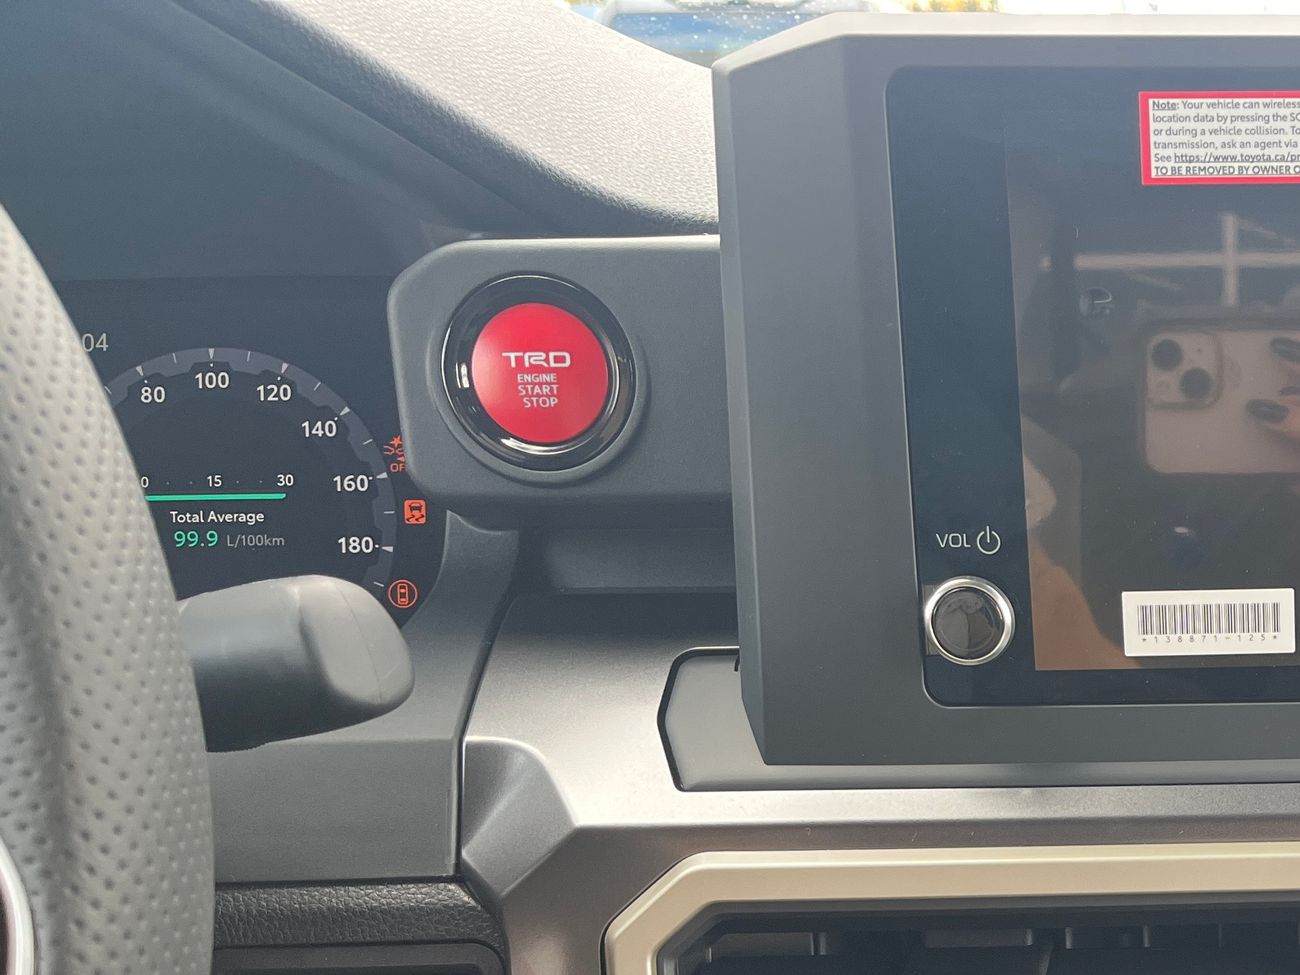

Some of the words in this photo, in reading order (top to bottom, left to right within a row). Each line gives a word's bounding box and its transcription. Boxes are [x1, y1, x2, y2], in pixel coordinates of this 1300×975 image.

[1152, 100, 1179, 110] Note:
[1182, 100, 1204, 110] Your
[1206, 99, 1240, 109] vehicle
[1242, 101, 1260, 109] can
[1152, 113, 1190, 123] location
[1192, 113, 1215, 122] data
[1217, 113, 1228, 124] by
[1230, 114, 1270, 124] pressing
[1272, 112, 1288, 122] the
[1165, 127, 1198, 138] during
[1208, 126, 1242, 136] vehicle
[1244, 126, 1288, 136] collision.
[1154, 140, 1218, 150] transmission,
[1220, 140, 1237, 148] ask
[1254, 140, 1282, 150] agent
[1284, 139, 1298, 148] via
[1154, 153, 1172, 162] See
[1154, 166, 1169, 176] TO
[1170, 166, 1183, 176] BE
[1185, 166, 1236, 176] REMOVED
[1238, 166, 1250, 175] BY
[1252, 165, 1291, 175] OWNER
[501, 351, 572, 369] TRD
[194, 372, 230, 389] 100
[517, 373, 558, 383] ENGINE
[140, 386, 166, 404] 80
[256, 384, 292, 402] 120
[518, 384, 560, 395] START
[523, 396, 559, 408] STOP
[301, 420, 337, 438] 140
[140, 476, 150, 488] 0
[206, 475, 222, 488] 15
[276, 474, 294, 486] 30
[332, 474, 369, 492] 160
[170, 510, 205, 524] Total
[207, 510, 265, 526] Average
[174, 530, 219, 548] 99.9
[226, 534, 285, 548] L/100km
[337, 536, 374, 554] 180
[935, 533, 972, 548] VOL
